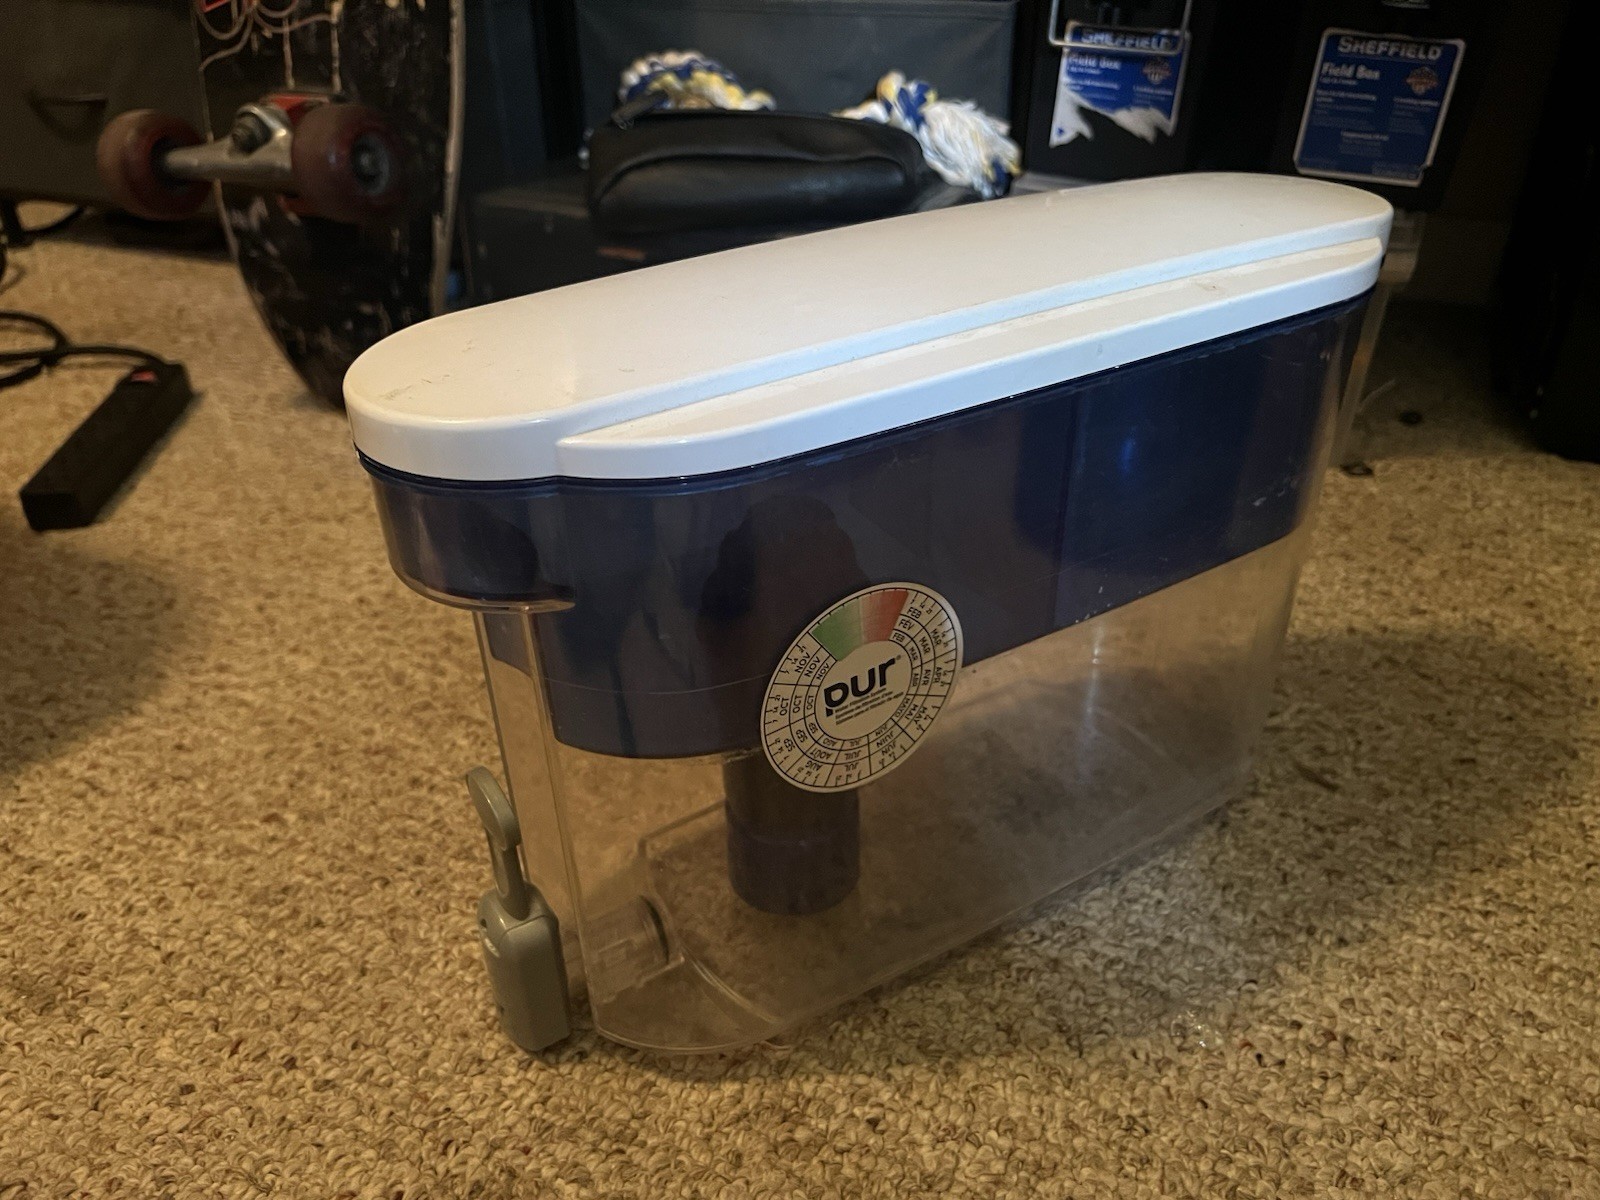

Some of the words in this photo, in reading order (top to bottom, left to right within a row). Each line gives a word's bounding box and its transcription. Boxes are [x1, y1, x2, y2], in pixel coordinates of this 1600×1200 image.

[1338, 36, 1443, 60] SHEFFIELD
[1321, 62, 1355, 78] Field
[907, 606, 922, 619] FEB
[898, 618, 915, 631] FÉV
[919, 636, 931, 654] MAR
[930, 628, 942, 647] MAR
[795, 652, 810, 674] NOV
[804, 656, 821, 677] NOV
[816, 663, 829, 681] NOV
[922, 669, 931, 686] AVR
[823, 658, 896, 717] pur
[780, 697, 789, 716] OCT
[792, 695, 802, 713] OCT
[806, 695, 814, 710] OCT
[905, 704, 918, 719] MAI
[914, 706, 928, 725] MAY
[796, 729, 808, 743] SEP
[876, 730, 894, 748] JUIN
[783, 738, 795, 752] SEP
[881, 740, 897, 756] JUN
[805, 760, 823, 771] AUG
[844, 761, 859, 772] JUL
